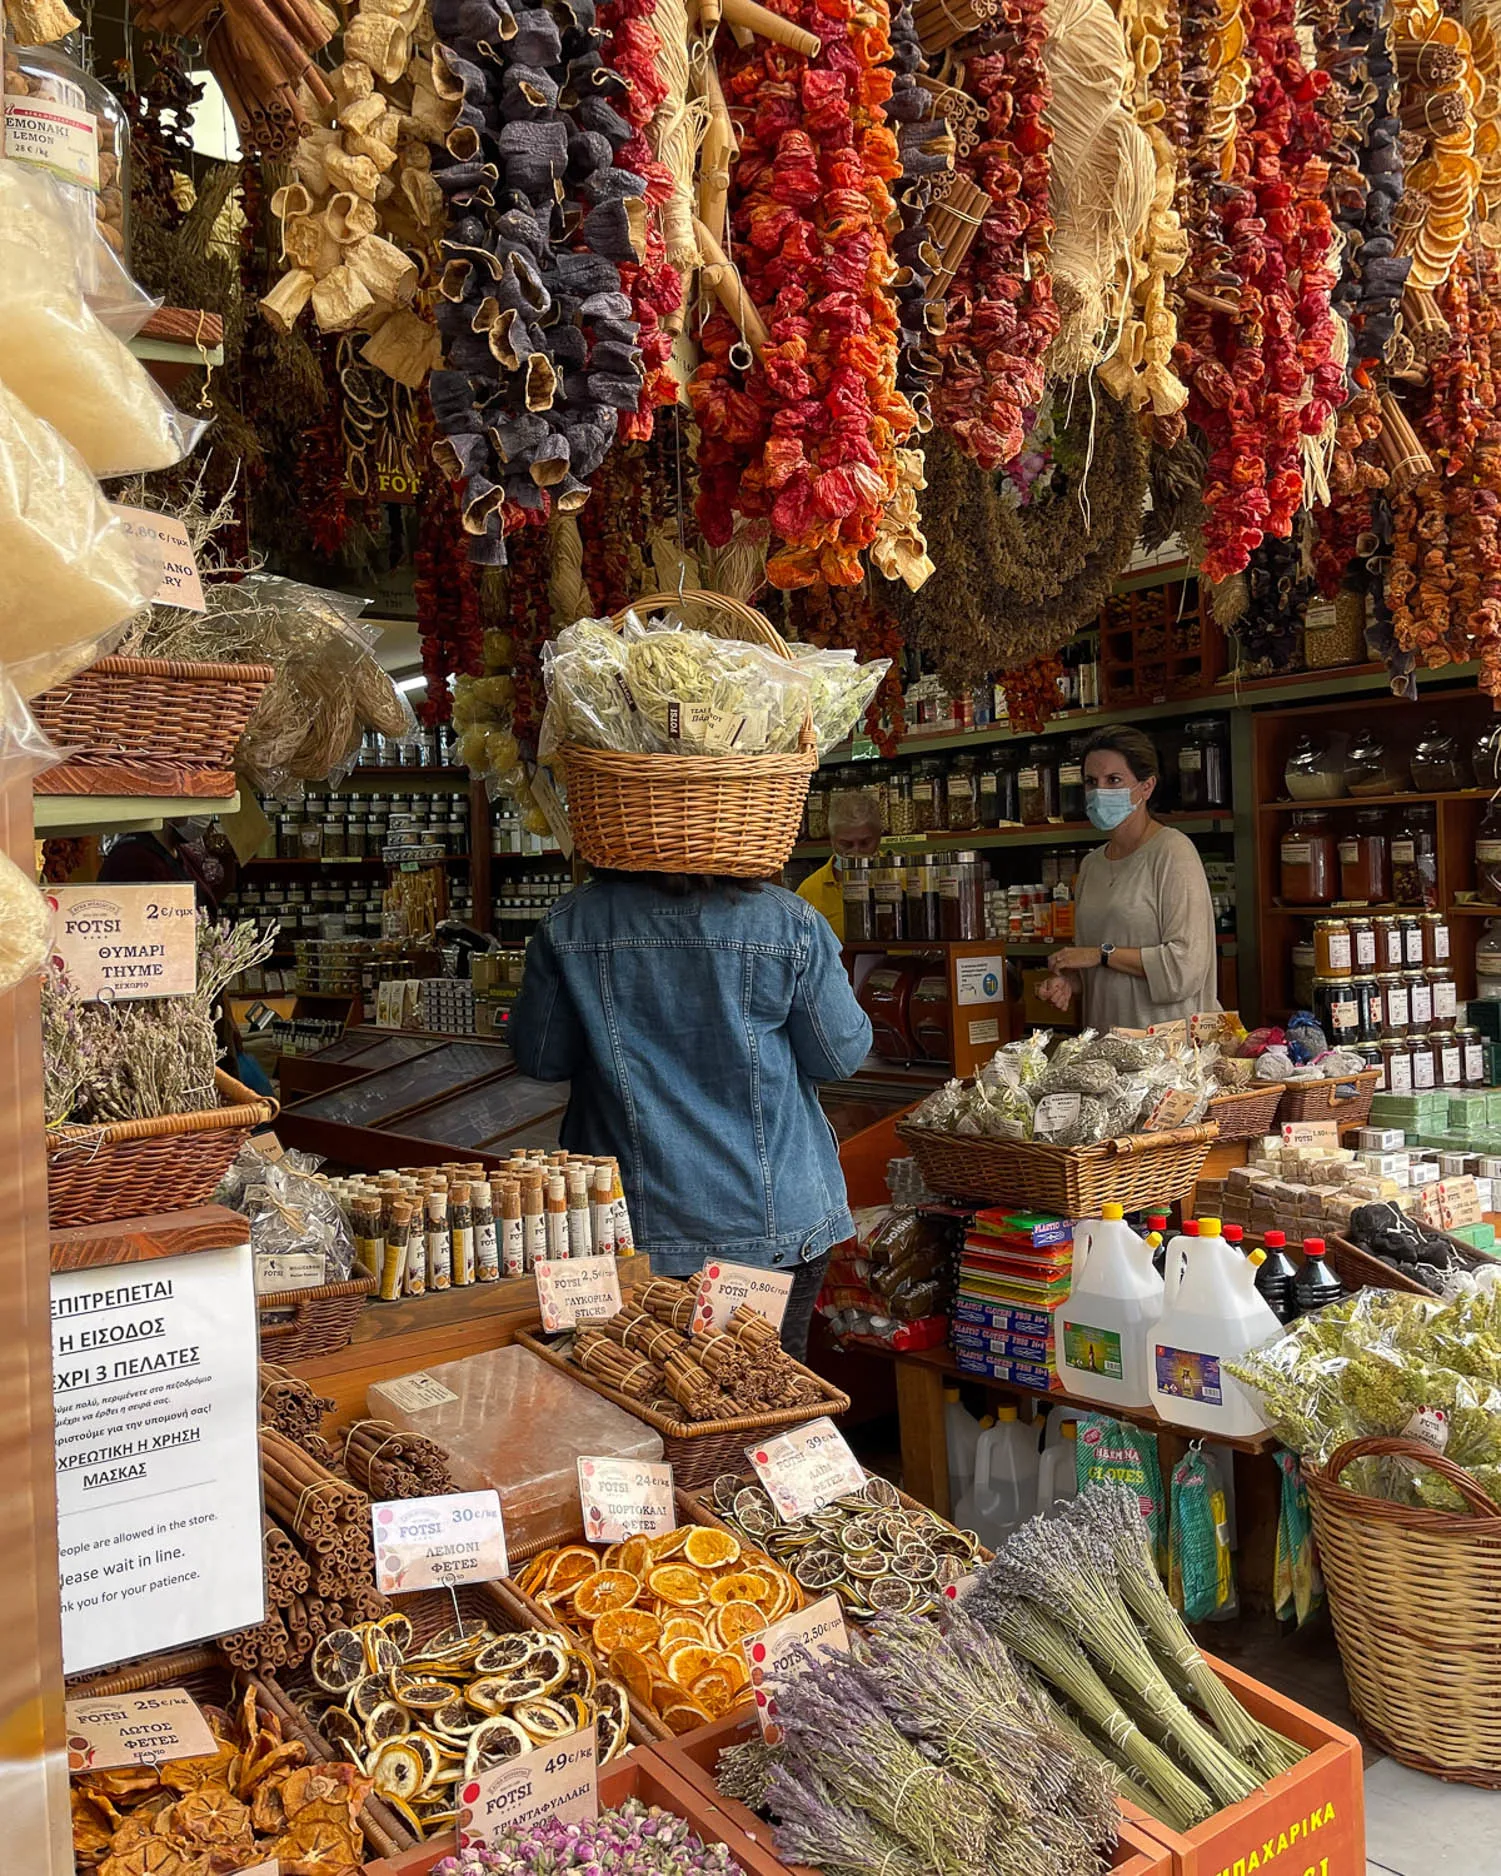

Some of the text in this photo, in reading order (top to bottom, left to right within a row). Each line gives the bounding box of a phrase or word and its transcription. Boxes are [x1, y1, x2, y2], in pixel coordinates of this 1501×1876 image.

[5, 118, 69, 137] EMONAKI
[13, 131, 54, 145] LEMON
[379, 475, 420, 494] FOT
[65, 919, 121, 934] FOTSI
[98, 945, 165, 959] ΘΥΜΑΡΙ
[102, 964, 163, 979] THYME
[554, 1278, 581, 1288] FOTSI
[718, 1284, 748, 1298] FOTSI
[575, 1307, 606, 1318] STICKS
[59, 1317, 165, 1352] Η ΕΙΣΟΔΟΣ
[97, 1365, 107, 1382] 3
[114, 1346, 200, 1378] ΠΕΛΑΤΕΣ
[165, 1375, 212, 1393] πεζοδρόμιο
[55, 1404, 212, 1447] ριστούμε για την υπομονή σας!
[82, 1413, 94, 1422] να
[56, 1427, 200, 1470] ΧΡΕΩΤΙΚΗ Η ΧΡΗΣΗ
[776, 1452, 807, 1471] FOTSI
[83, 1462, 147, 1488] ΜΑΣΚΑΣ
[1088, 1466, 1145, 1483] GLOVES
[598, 1480, 629, 1493] FOTSI
[608, 1504, 667, 1516] ΠΟΡΤΟΚΑΛΙ
[400, 1522, 442, 1538] FOTSI
[622, 1520, 656, 1530] ΦΕΤΕΣ
[60, 1511, 218, 1558] eople are allowed in the store.
[425, 1541, 480, 1558] ΛΕΜΟΝΙ
[60, 1547, 186, 1590] lease wait in line.
[431, 1558, 478, 1573] ΦΕΤΕΣ
[77, 1596, 98, 1613] you
[101, 1590, 118, 1603] for
[121, 1583, 148, 1600] your
[149, 1569, 200, 1592] patience.
[772, 1652, 805, 1673] FOTS
[133, 1698, 189, 1711] 25€/kg
[77, 1711, 129, 1724] FOTSI
[119, 1722, 173, 1737] ΛΩΤΟΣ
[124, 1734, 180, 1750] ΦΕΤΕΣ
[544, 1747, 593, 1774] 49€/kg
[486, 1782, 533, 1815] FOTSI
